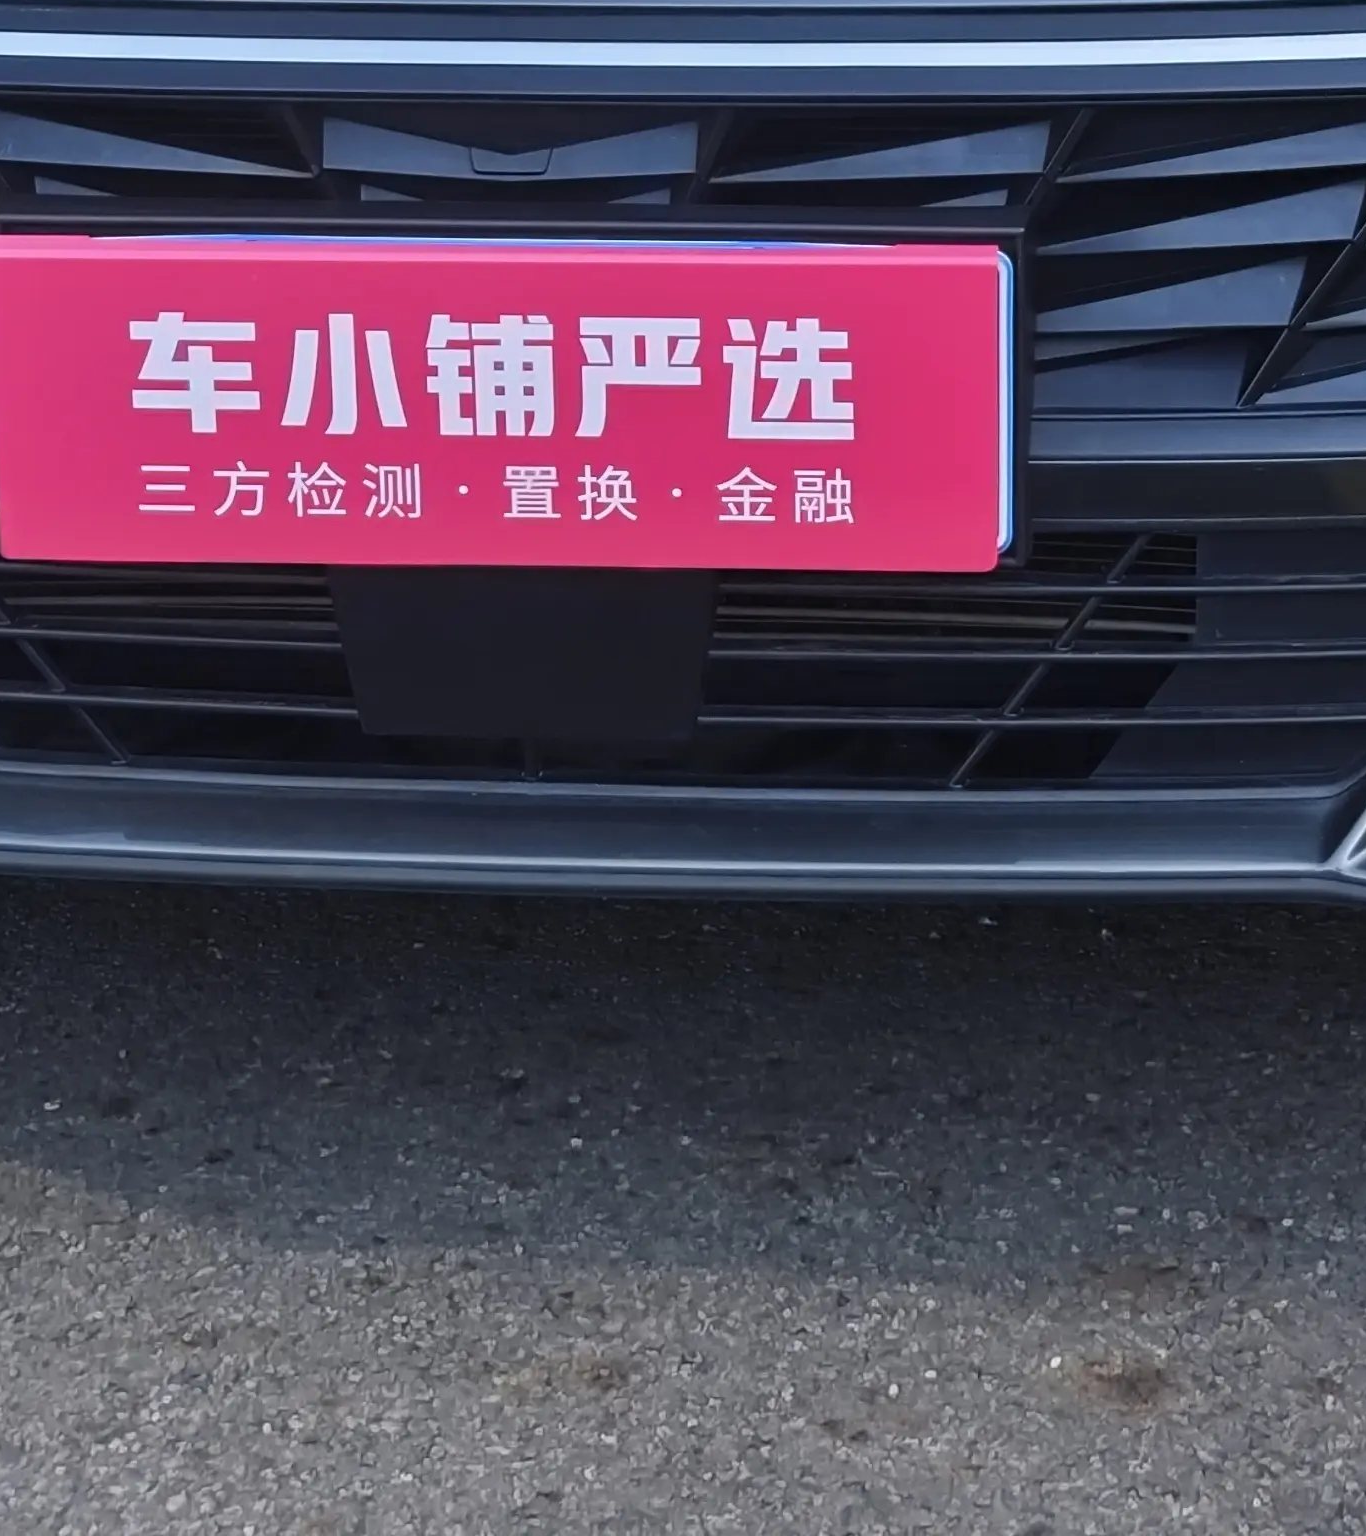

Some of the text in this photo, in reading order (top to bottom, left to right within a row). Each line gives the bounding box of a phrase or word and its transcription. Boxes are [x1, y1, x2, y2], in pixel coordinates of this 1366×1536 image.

[128, 310, 856, 441] 车小铺严选
